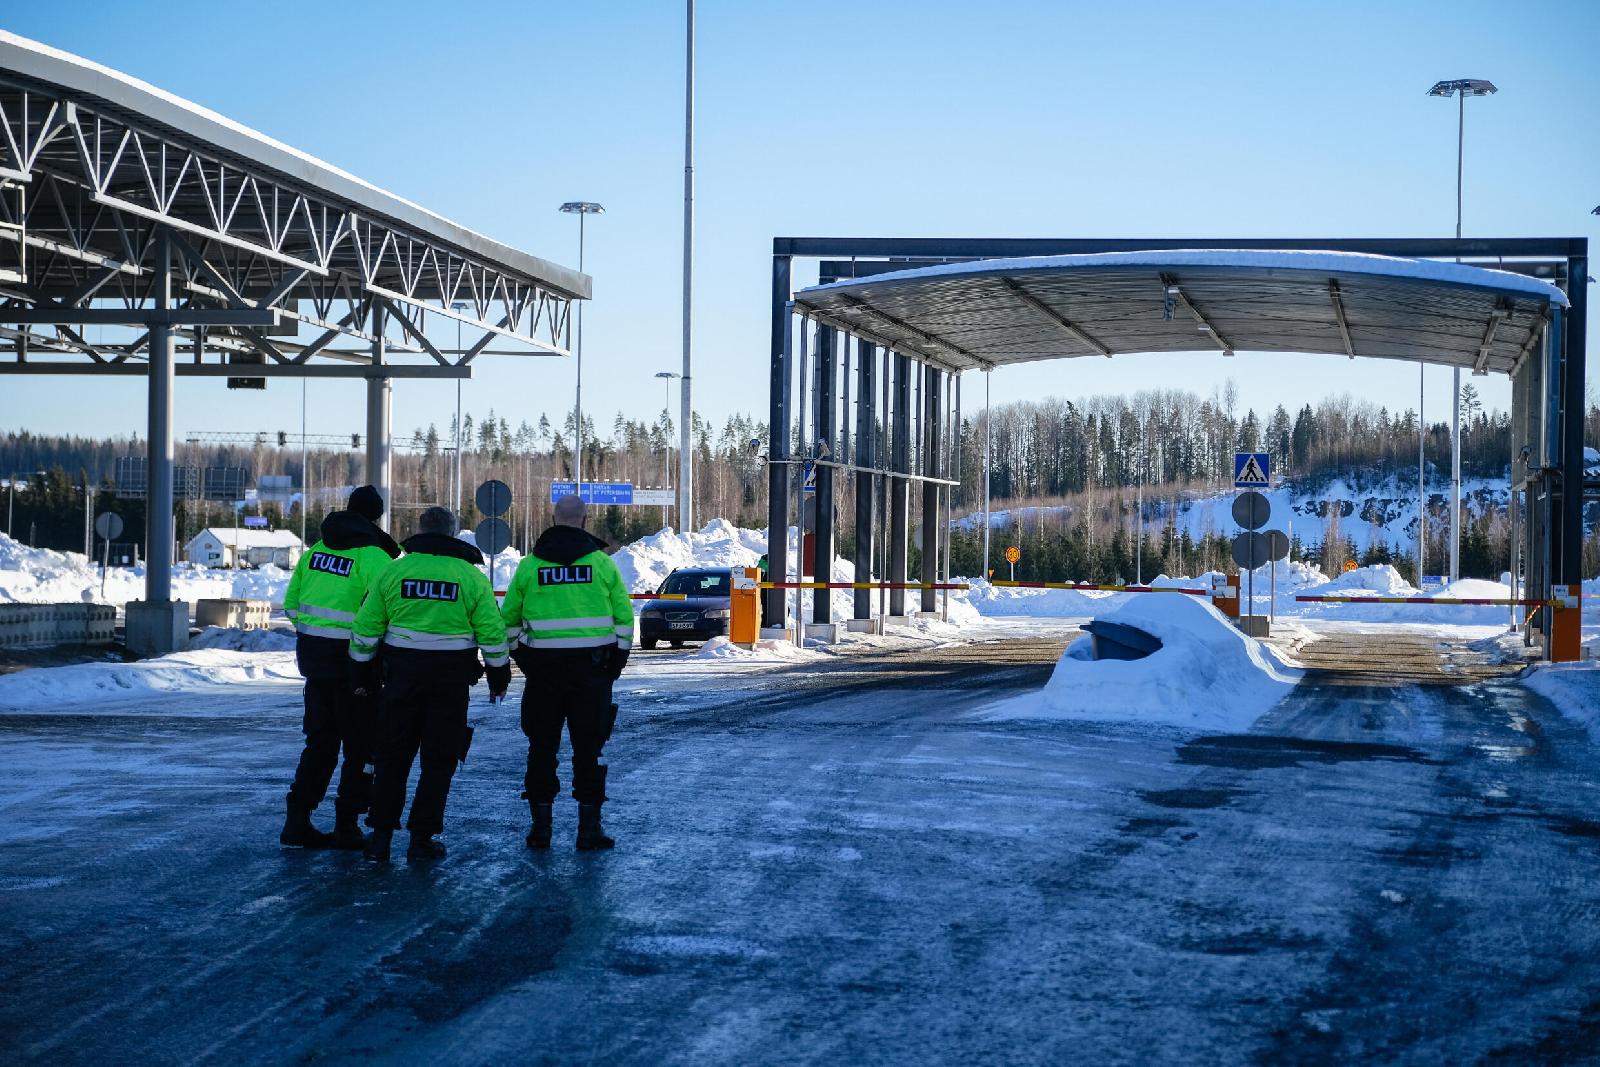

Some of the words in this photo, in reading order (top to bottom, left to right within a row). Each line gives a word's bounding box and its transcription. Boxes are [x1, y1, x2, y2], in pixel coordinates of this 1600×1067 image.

[313, 553, 352, 575] TULLI
[539, 566, 591, 584] TULLI
[404, 581, 457, 600] TULLI
